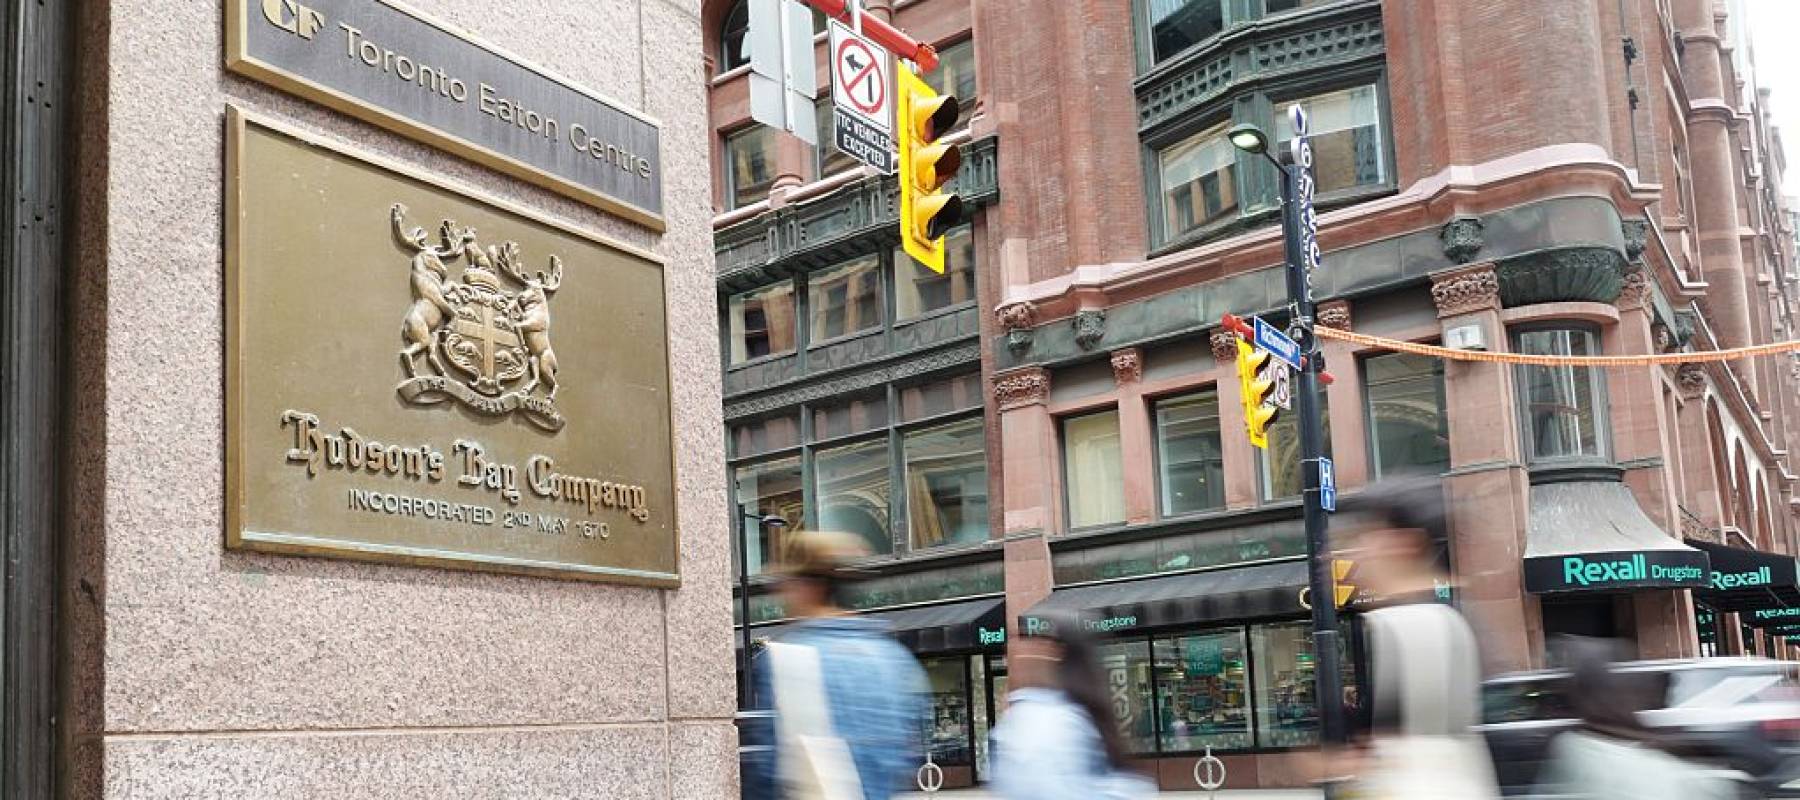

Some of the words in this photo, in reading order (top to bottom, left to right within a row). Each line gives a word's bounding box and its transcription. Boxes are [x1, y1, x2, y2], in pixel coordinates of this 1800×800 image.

[339, 21, 469, 103] Toronto
[479, 82, 560, 142] Eaton
[569, 123, 653, 181] Centre
[837, 112, 852, 131] TTC
[843, 134, 885, 167] EXCEPTED
[281, 409, 445, 478] Hudson's
[453, 440, 520, 505] Bay
[526, 454, 649, 523] Company
[1322, 462, 1331, 487] H
[348, 489, 495, 526] INCORPORATED
[503, 512, 532, 530] 2ND
[536, 515, 570, 537] MAY
[1563, 553, 1646, 586] Rexall
[1652, 563, 1702, 582] Drugstore
[1711, 566, 1772, 590] Rexall
